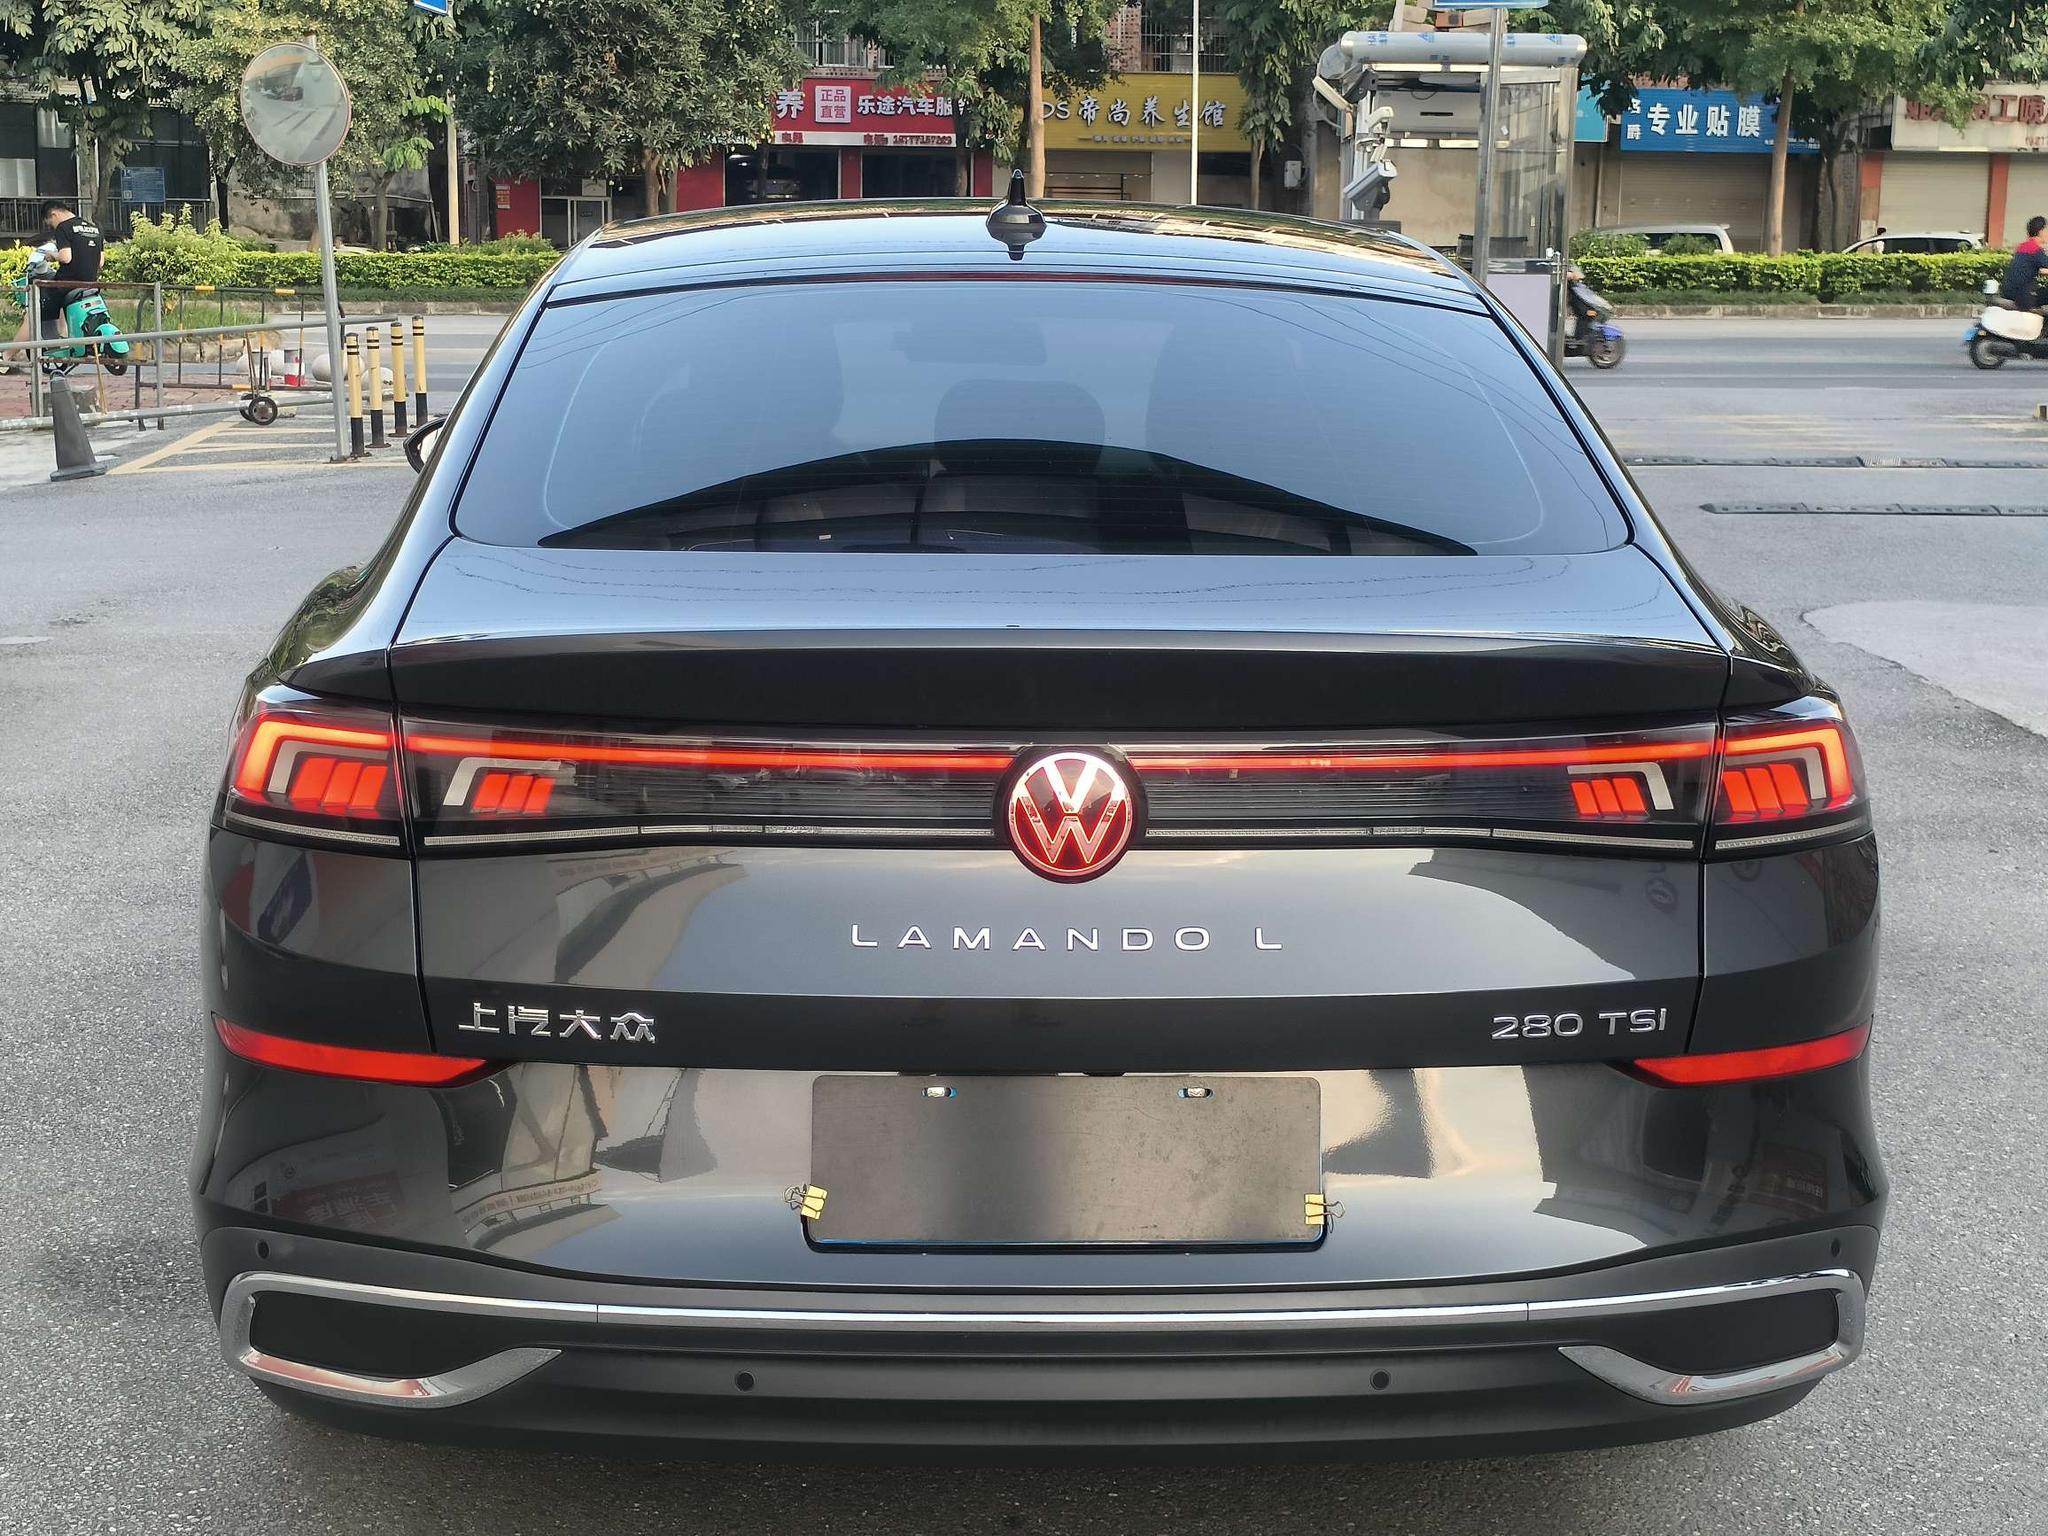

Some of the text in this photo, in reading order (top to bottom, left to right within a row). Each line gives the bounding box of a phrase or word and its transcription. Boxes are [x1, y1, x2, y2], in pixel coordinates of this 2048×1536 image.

[820, 89, 846, 102] 正品
[820, 105, 846, 118] 直营
[1078, 95, 1226, 128] 帝尚养生馆
[1647, 102, 1762, 138] 专业贴膜
[1011, 753, 1130, 868] VW
[851, 924, 1284, 951] LAMANDO L
[458, 1002, 656, 1044] 上汽大众
[1491, 1007, 1667, 1039] 280 TSI
